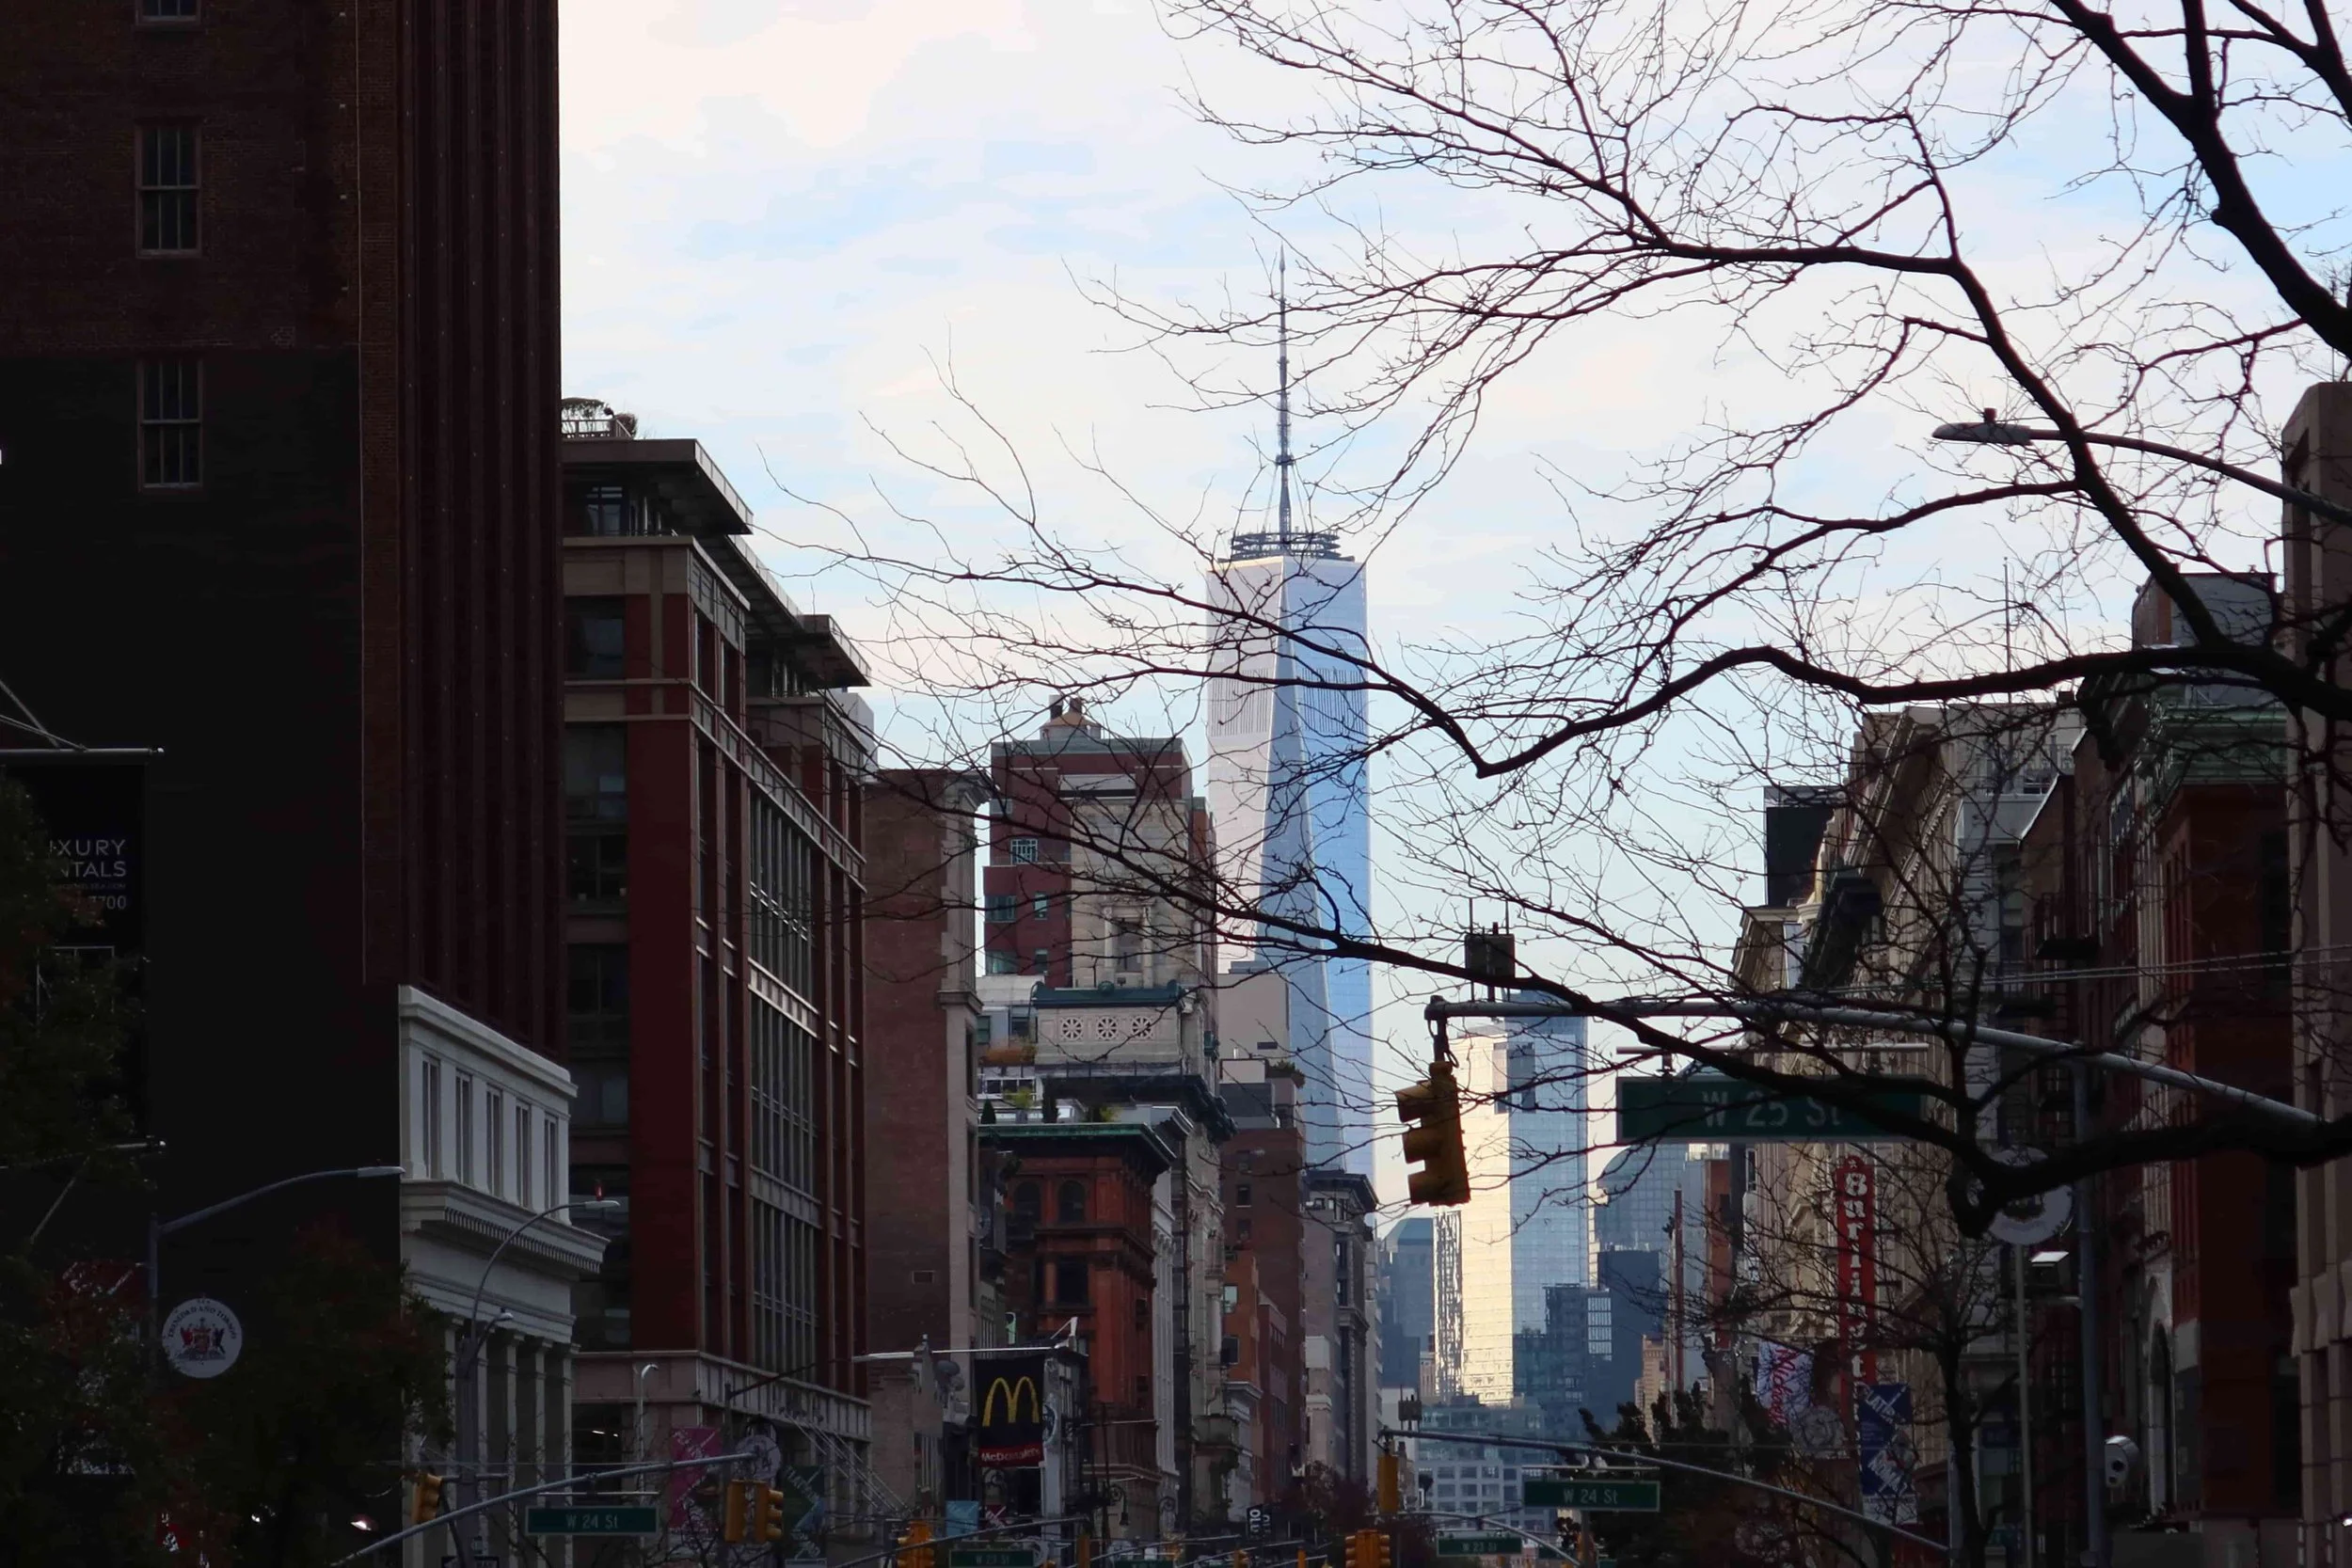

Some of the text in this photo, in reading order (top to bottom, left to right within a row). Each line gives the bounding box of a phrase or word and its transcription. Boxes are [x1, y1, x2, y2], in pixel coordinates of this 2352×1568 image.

[1701, 1091, 1728, 1128] W
[1746, 1090, 1788, 1127] 25
[1563, 1489, 1618, 1504] W 24 St
[565, 1514, 618, 1529] W 24 St
